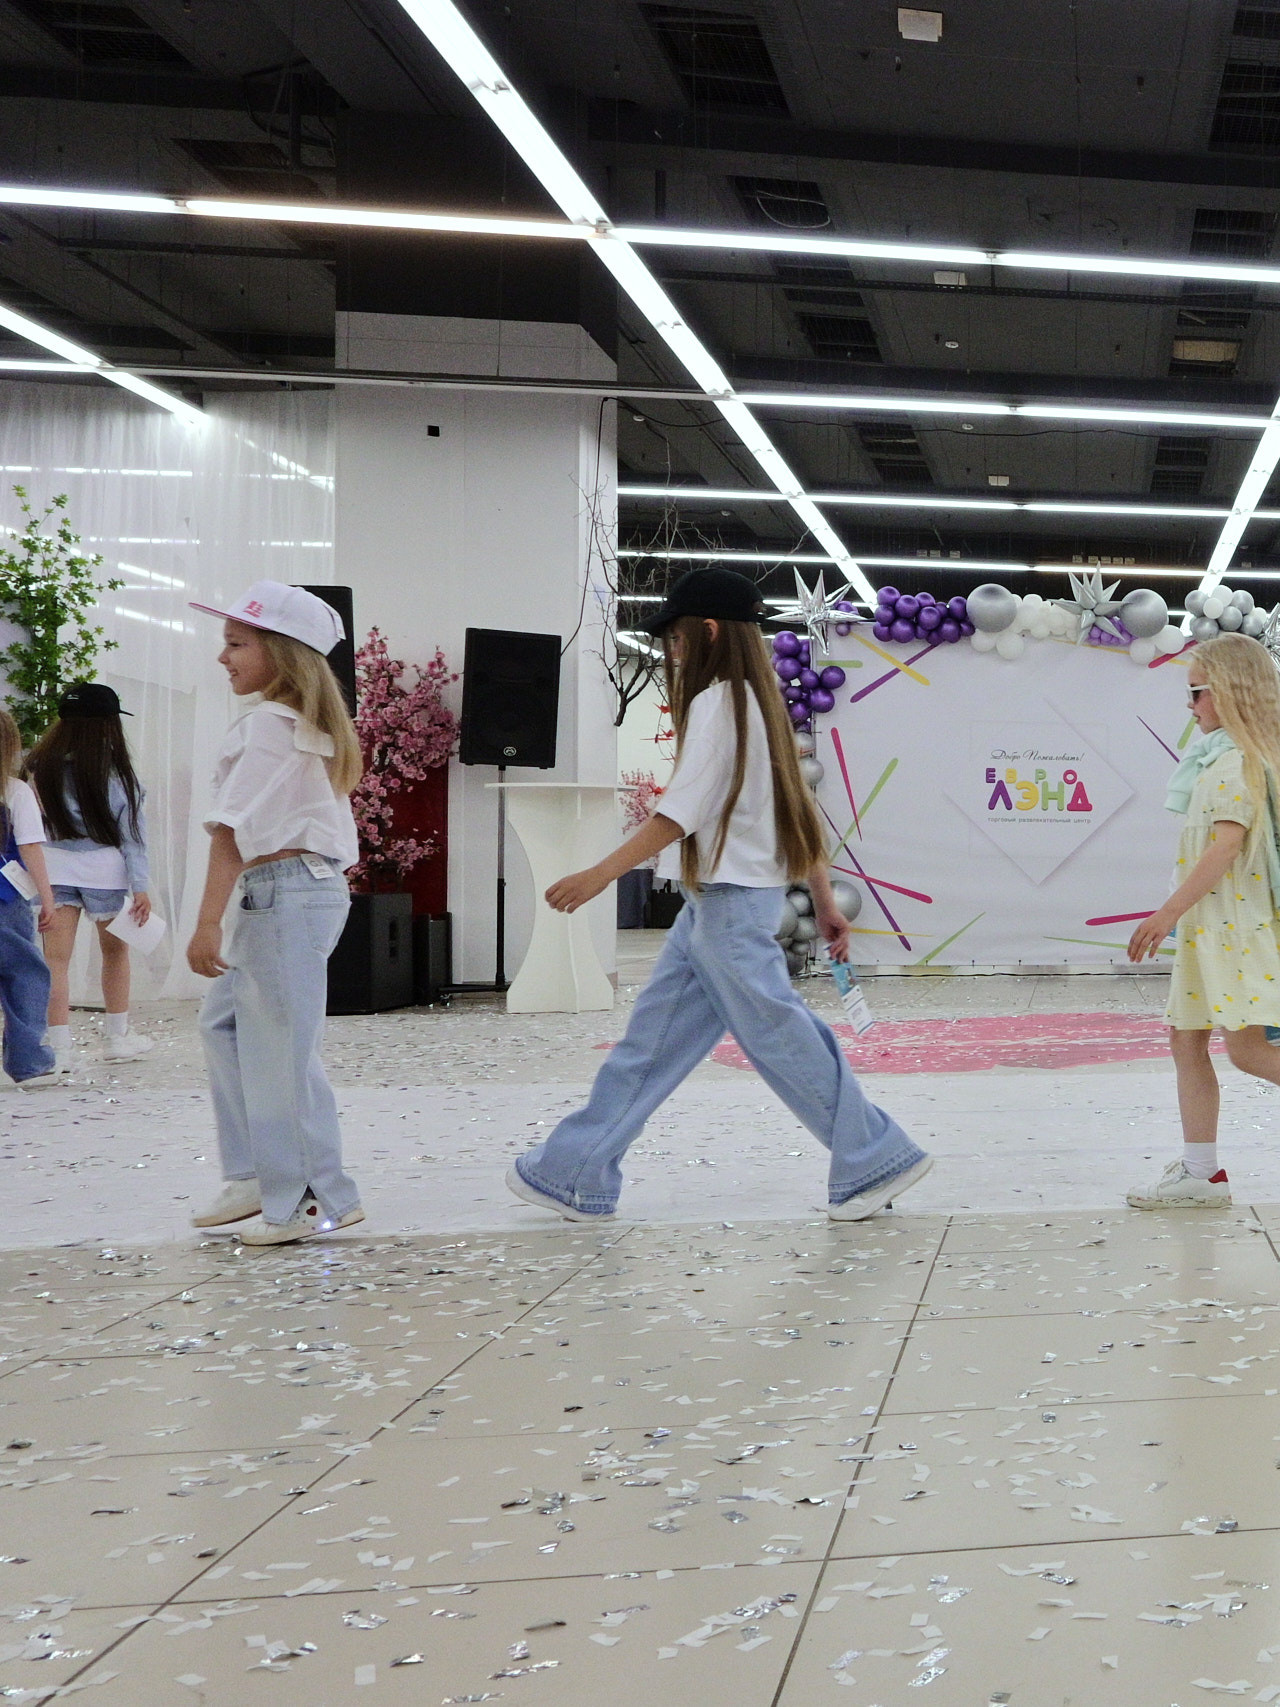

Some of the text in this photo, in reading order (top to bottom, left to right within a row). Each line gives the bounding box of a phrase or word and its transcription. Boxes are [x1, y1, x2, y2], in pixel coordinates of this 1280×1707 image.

[990, 749, 1085, 762] Добро Пожаловать!
[988, 780, 1093, 811] ЛЭНД
